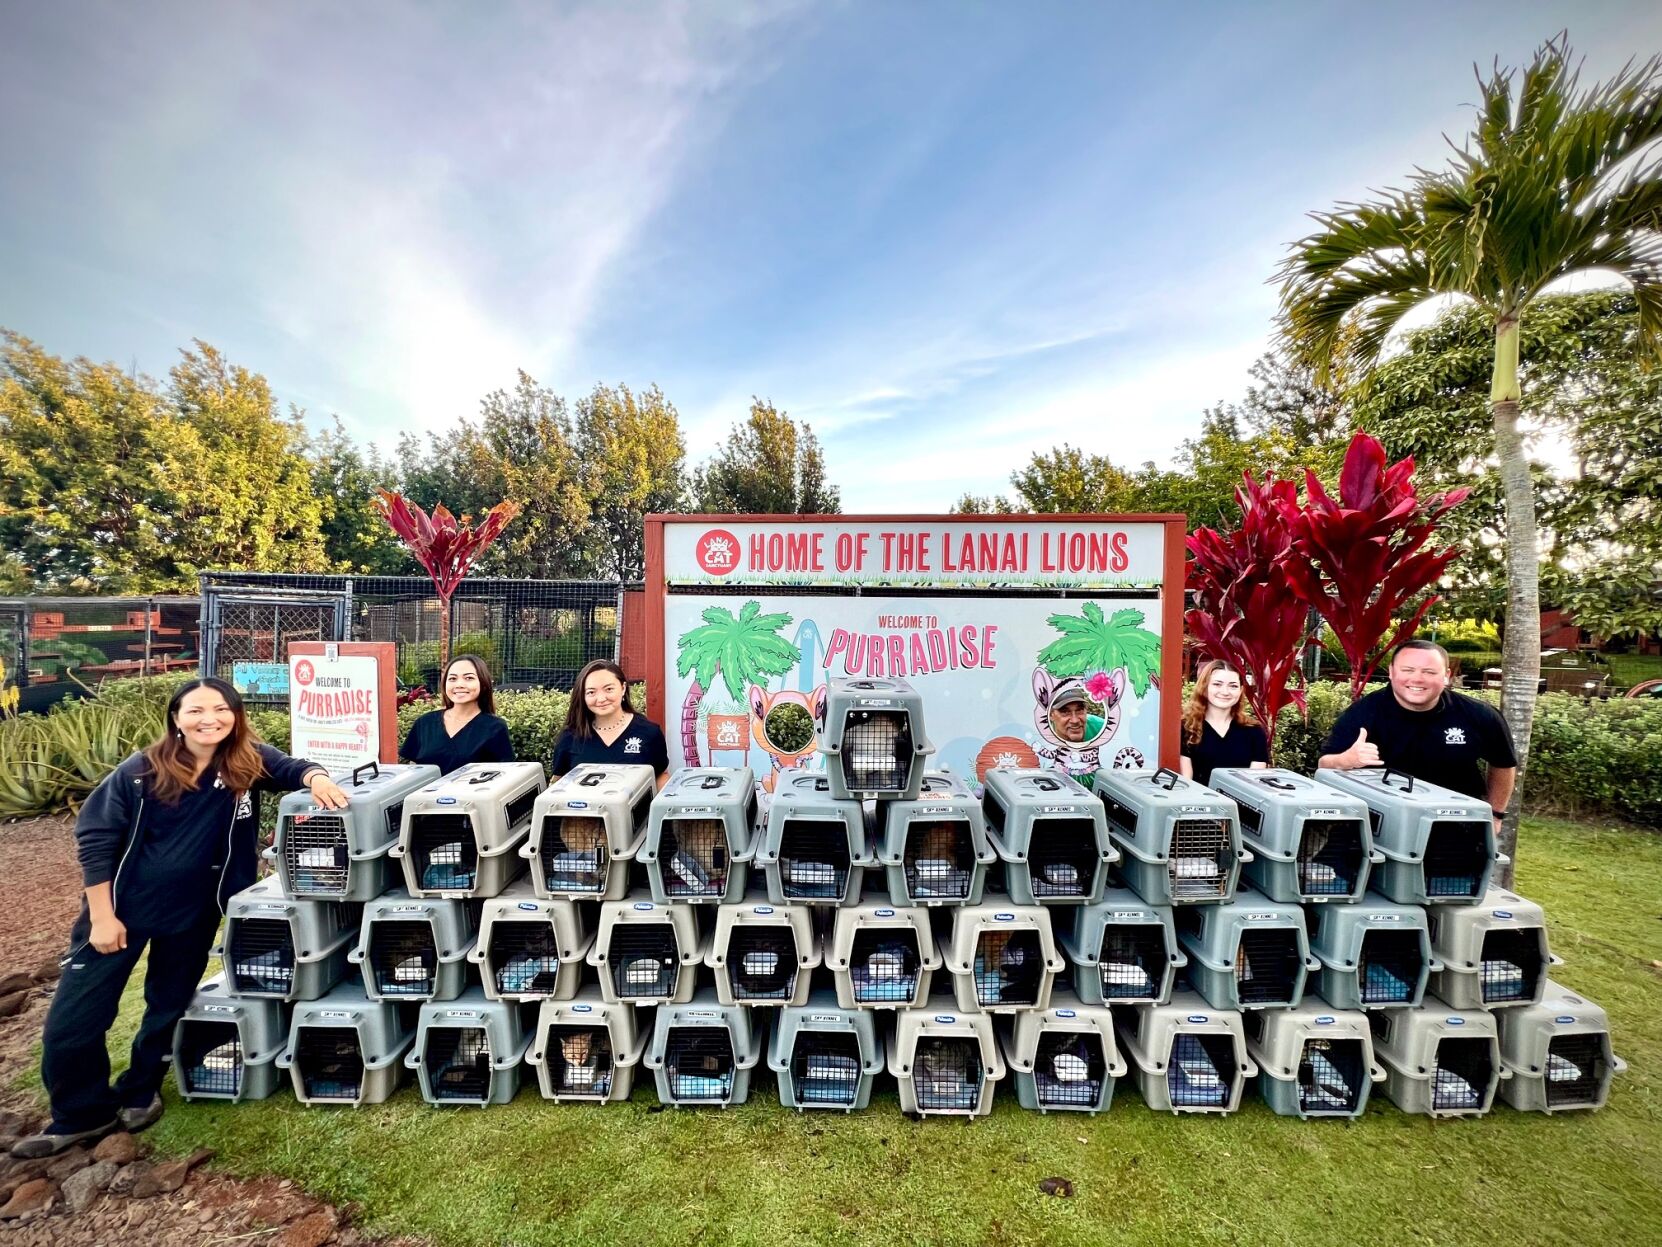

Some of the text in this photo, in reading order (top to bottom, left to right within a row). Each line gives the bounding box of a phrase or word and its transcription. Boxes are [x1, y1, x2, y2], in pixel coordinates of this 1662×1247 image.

[704, 551, 733, 564] CAT
[749, 531, 1129, 573] HOME OF THE LANAI LIONS
[878, 615, 938, 629] WELCOME TO
[823, 625, 998, 678] PURRADISE
[316, 677, 351, 688] WELCOME TO
[298, 688, 373, 718] PURRADISE
[717, 733, 740, 743] CAT
